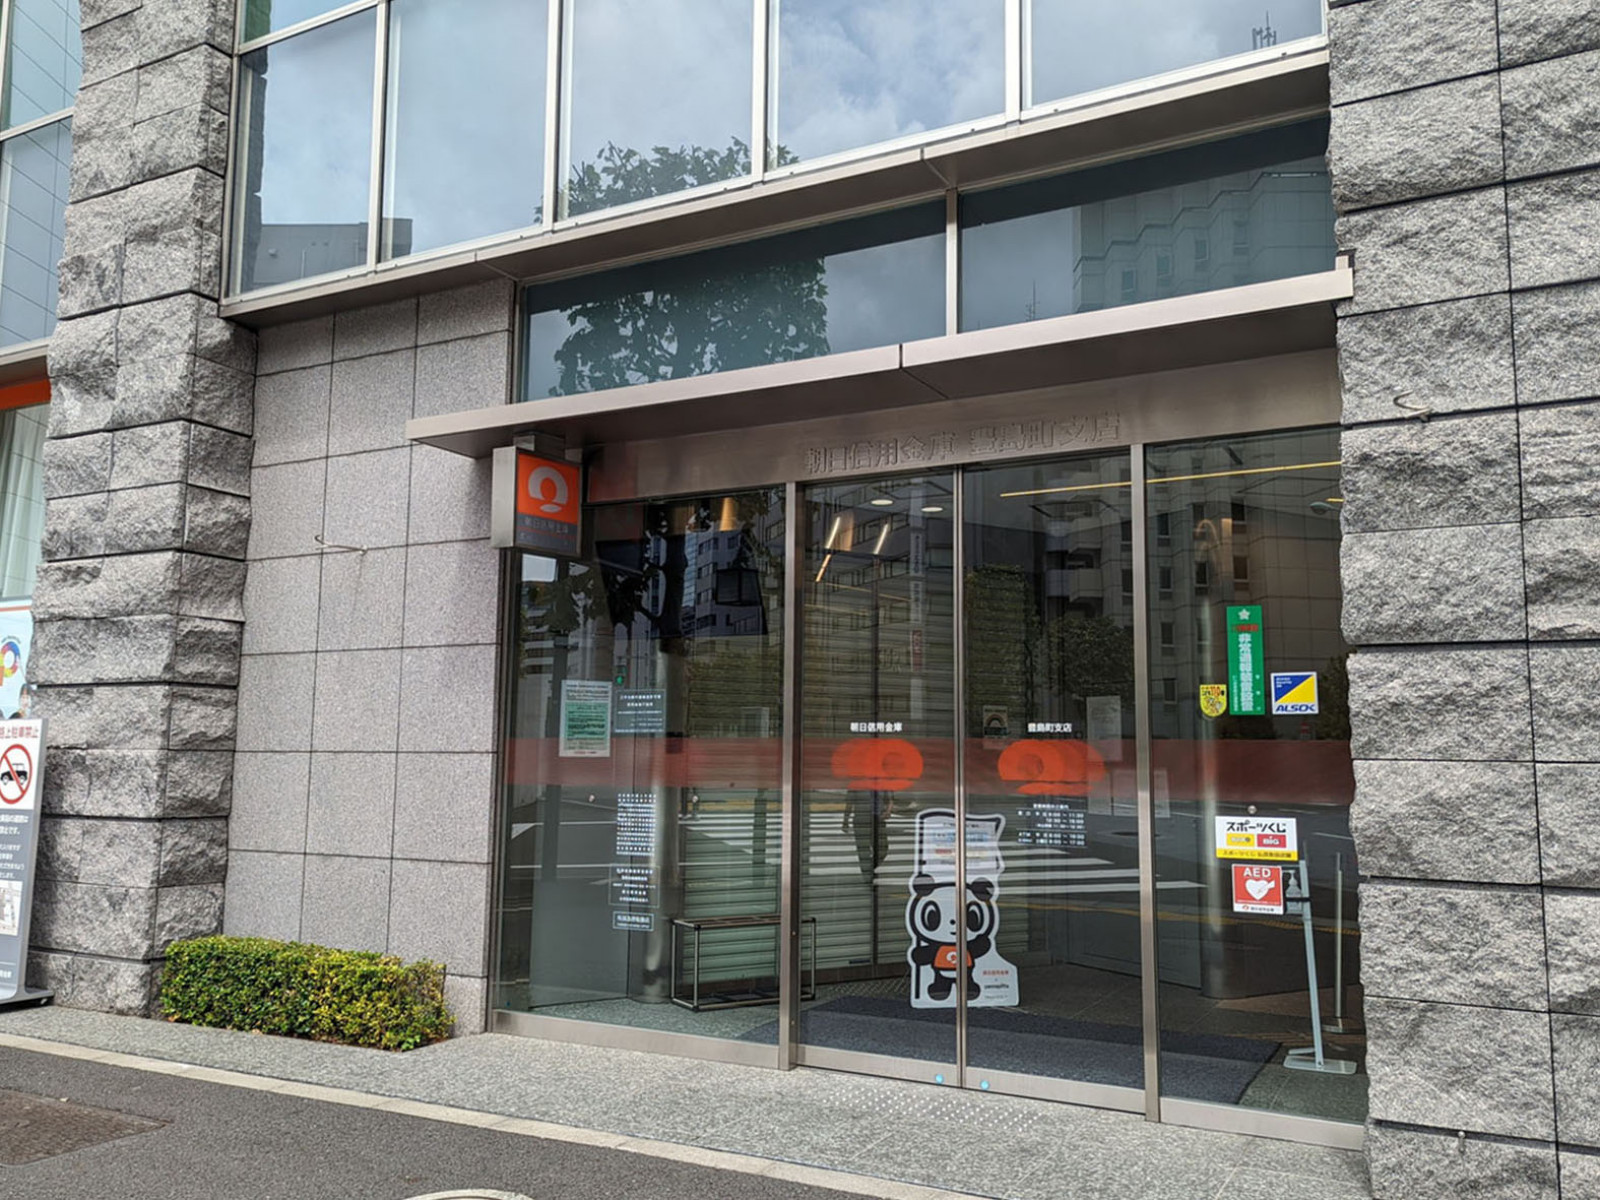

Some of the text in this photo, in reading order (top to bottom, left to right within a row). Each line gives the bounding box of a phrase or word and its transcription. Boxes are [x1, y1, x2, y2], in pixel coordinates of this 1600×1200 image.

[804, 431, 958, 474] 朝日信用金庫
[1275, 704, 1316, 712] ALSOK
[850, 722, 902, 733] 朝日信用金庫
[1226, 820, 1286, 833] スポーツくじ
[1243, 867, 1272, 878] AED
